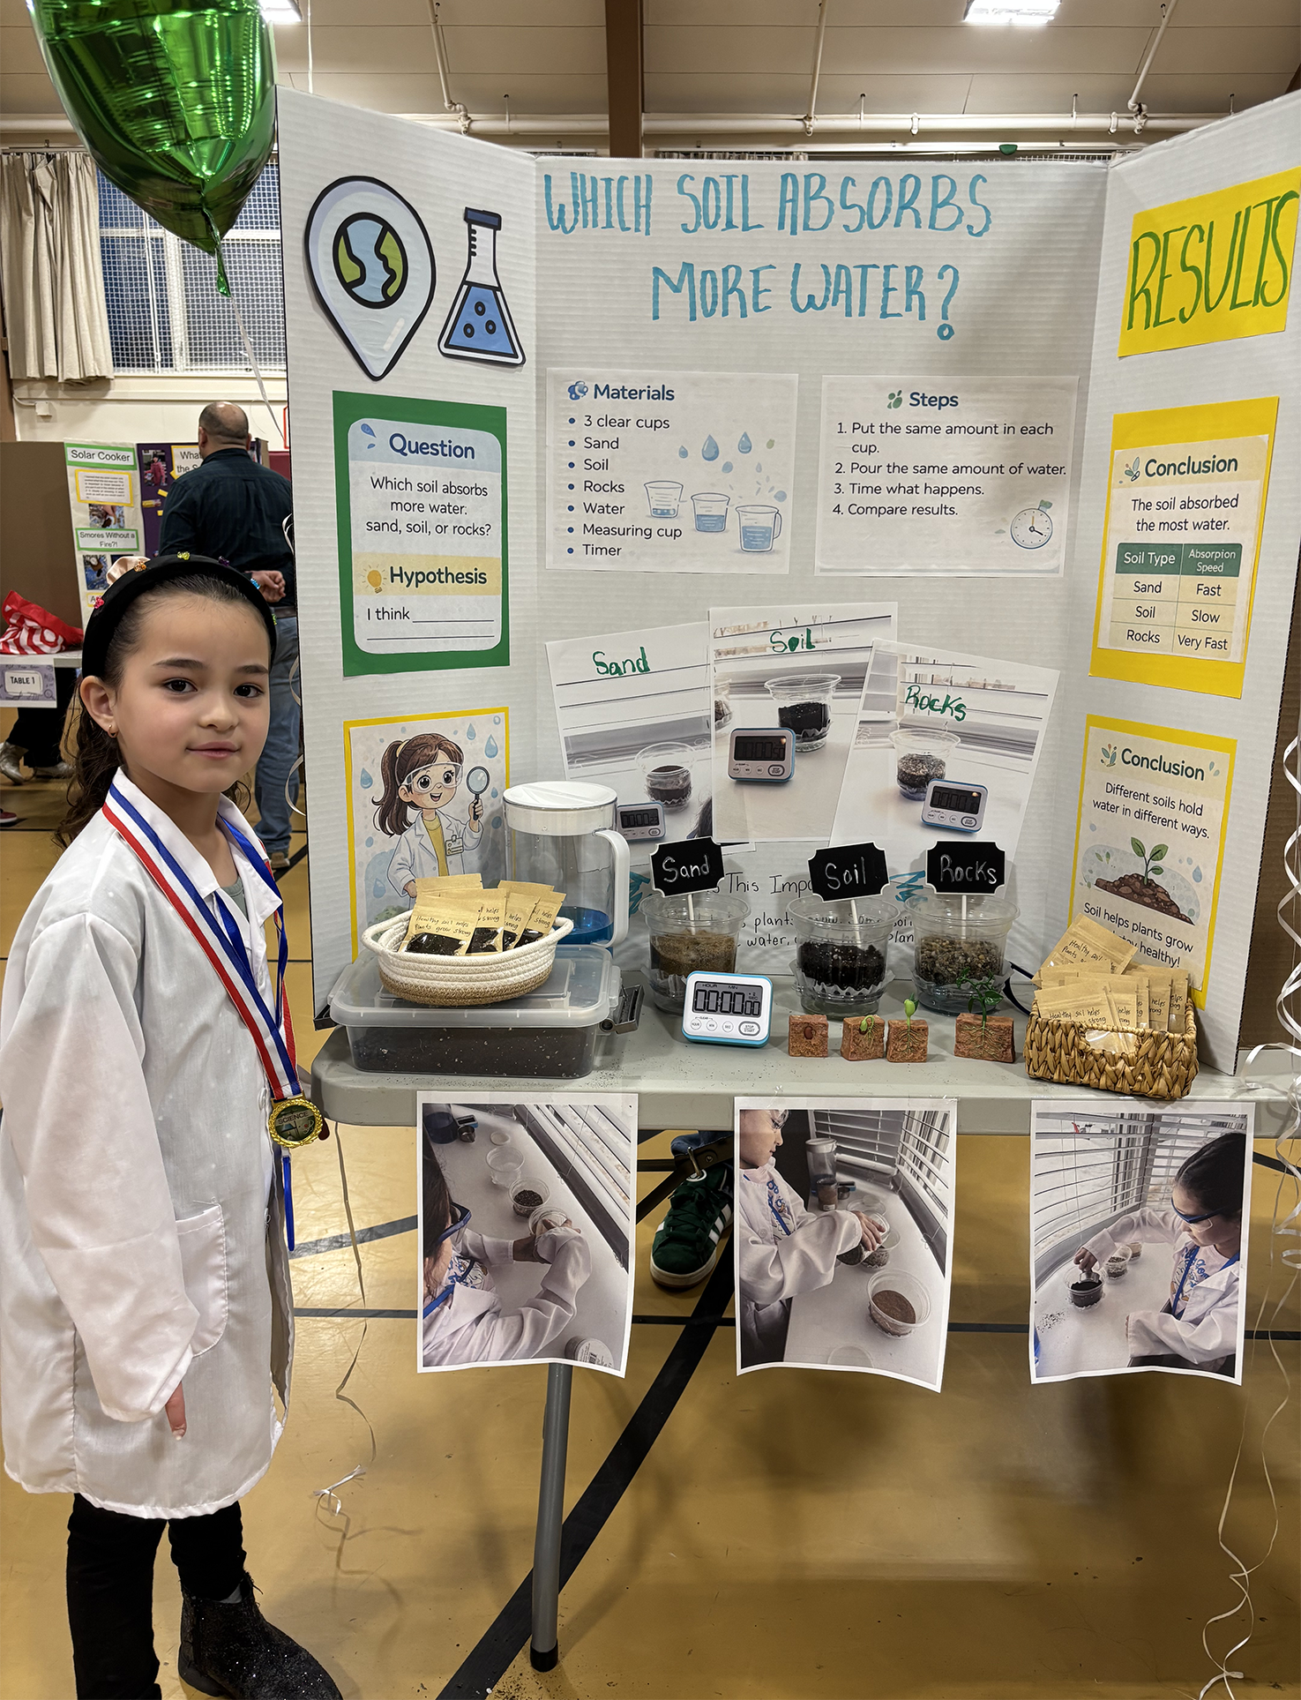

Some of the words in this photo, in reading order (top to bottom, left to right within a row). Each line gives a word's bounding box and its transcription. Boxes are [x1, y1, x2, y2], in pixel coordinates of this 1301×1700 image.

[544, 172, 653, 235] WHICH
[677, 174, 764, 233] SOIL
[778, 173, 992, 237] ABSORBS
[1127, 190, 1300, 331] RESULTS
[652, 262, 777, 322] MORE
[791, 263, 959, 341] WATER?
[593, 383, 675, 402] Materials
[909, 391, 960, 411] Steps
[584, 415, 593, 429] 3
[597, 415, 632, 429] clear
[635, 417, 670, 431] cups
[837, 422, 847, 435] 1.
[851, 422, 875, 435] Put
[878, 422, 901, 435] the
[906, 423, 941, 435] same
[945, 424, 999, 435] amount
[1003, 422, 1016, 435] in
[1020, 422, 1054, 435] each
[389, 433, 476, 460] Question
[584, 437, 619, 449] Sand
[852, 443, 880, 456] cup.
[71, 449, 96, 459] Solar
[97, 452, 130, 462] Cooker
[584, 458, 609, 471] Soil
[835, 462, 846, 476] 2.
[850, 463, 882, 475] Pour
[886, 463, 909, 475] the
[912, 464, 948, 475] same
[951, 464, 1005, 475] amount
[1008, 463, 1025, 475] of
[1027, 464, 1067, 476] water.
[1144, 455, 1239, 479] Conclusion
[370, 476, 413, 492] Which
[417, 480, 438, 495] soil
[442, 480, 488, 497] absorbs
[584, 480, 625, 493] Rocks
[834, 483, 845, 496] 3.
[849, 483, 882, 496] Time
[885, 483, 920, 496] what
[924, 483, 985, 498] happens.
[390, 501, 424, 514] more
[583, 502, 625, 515] Water
[832, 504, 844, 516] 4.
[848, 504, 908, 518] Compare
[911, 504, 959, 516] results.
[1131, 498, 1153, 511] The
[1156, 497, 1176, 510] soil
[1179, 495, 1239, 510] absorbed
[366, 518, 402, 536] sand,
[405, 520, 431, 536] soil,
[435, 523, 449, 535] or
[452, 521, 492, 537] rocks?
[582, 523, 652, 540] Measuring
[656, 526, 683, 540] cup
[1136, 519, 1156, 532] the
[1160, 519, 1190, 532] most
[1193, 518, 1231, 531] water.
[582, 544, 622, 556] Timer
[1188, 547, 1237, 562] Absorpion
[1123, 551, 1147, 566] Soil
[1149, 551, 1177, 568] Type
[1196, 561, 1224, 574] Speed
[389, 566, 487, 589] Hypothesis
[1133, 580, 1163, 595] Sand
[1196, 583, 1222, 597] Fast
[375, 606, 411, 621] think
[1135, 605, 1157, 619] Soil
[1191, 610, 1221, 624] Slow
[769, 628, 815, 653] Soil
[1126, 629, 1161, 644] Rocks
[1177, 633, 1201, 650] Very
[1203, 636, 1228, 650] Fast
[592, 647, 651, 677] Sand
[10, 676, 30, 685] TABLE
[32, 677, 35, 685] 1
[905, 685, 967, 721] Rocks
[1120, 748, 1205, 782] Conclusion
[1105, 782, 1150, 804] Different
[1152, 792, 1175, 810] soils
[1178, 797, 1203, 817] hold
[1092, 799, 1120, 816] water
[1122, 803, 1132, 817] in
[1133, 807, 1179, 832] different
[1181, 821, 1210, 840] ways.
[661, 854, 710, 883] Sand
[825, 856, 867, 890] Soil
[940, 853, 997, 885] Rocks
[726, 871, 760, 893] This
[1083, 902, 1102, 918] Soil
[1103, 907, 1130, 931] helps
[1131, 921, 1163, 945] plants
[1164, 933, 1194, 953] grow
[1139, 943, 1181, 969] healthy!
[278, 1112, 309, 1124] SCIENCE
